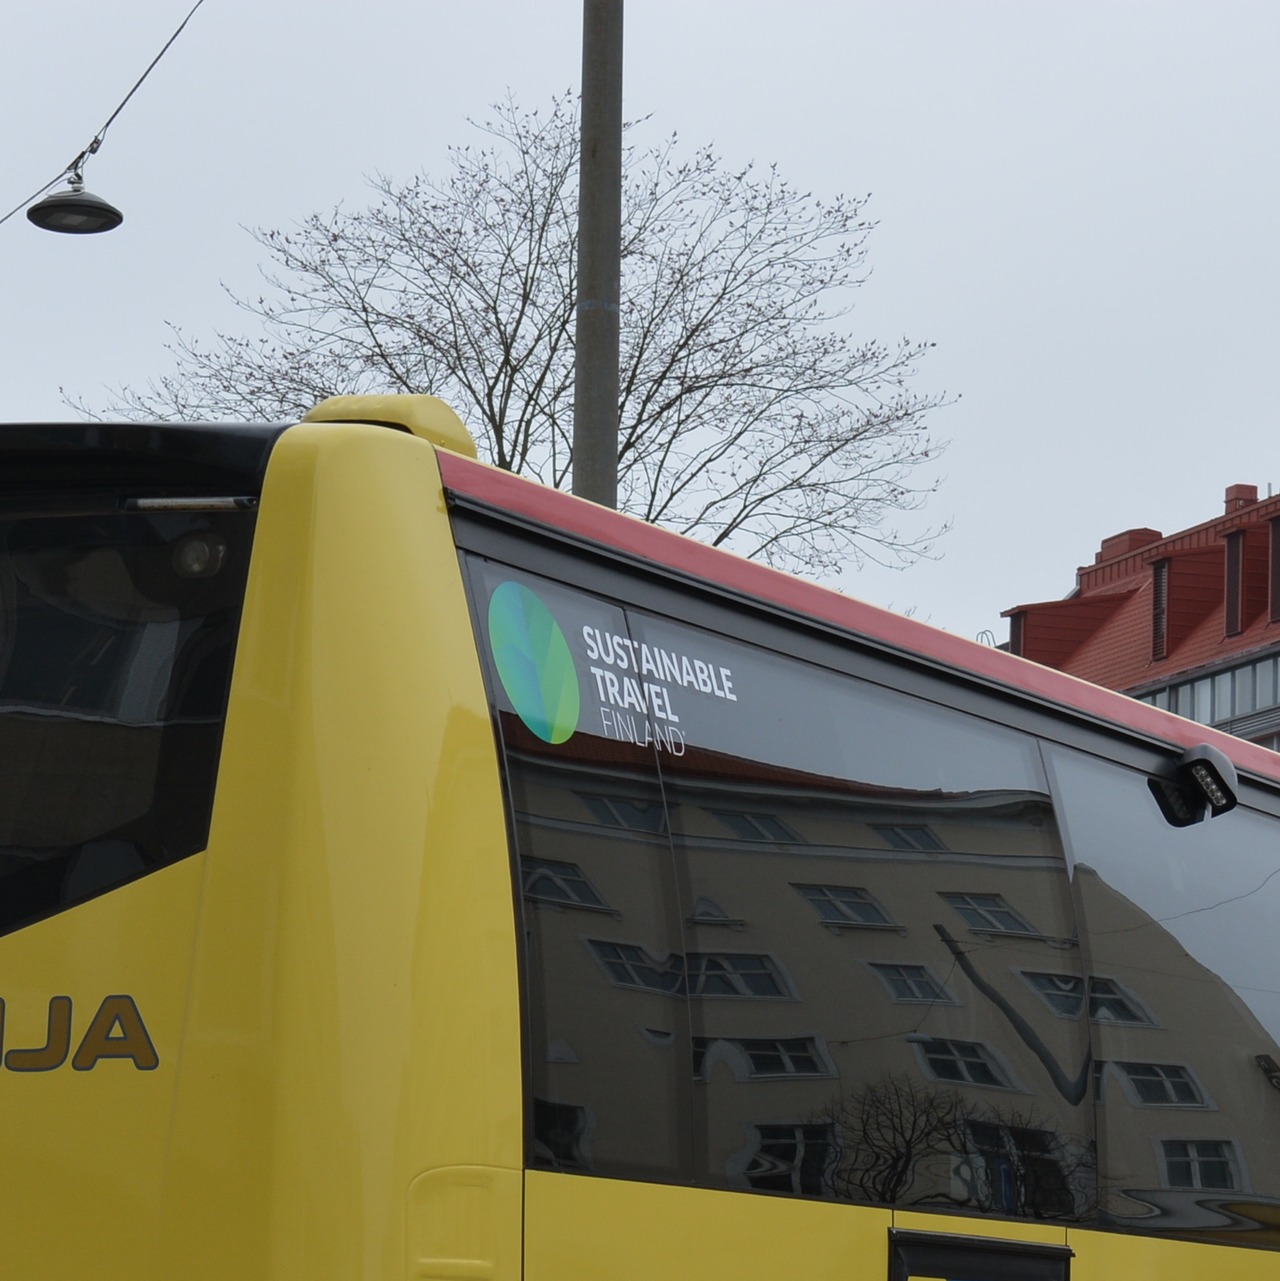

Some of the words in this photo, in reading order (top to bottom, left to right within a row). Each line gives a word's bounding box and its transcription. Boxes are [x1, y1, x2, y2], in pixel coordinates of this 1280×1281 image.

[582, 625, 738, 702] SUSTAINABLE
[590, 666, 680, 723] TRAVEL
[599, 706, 686, 757] FINLAND
